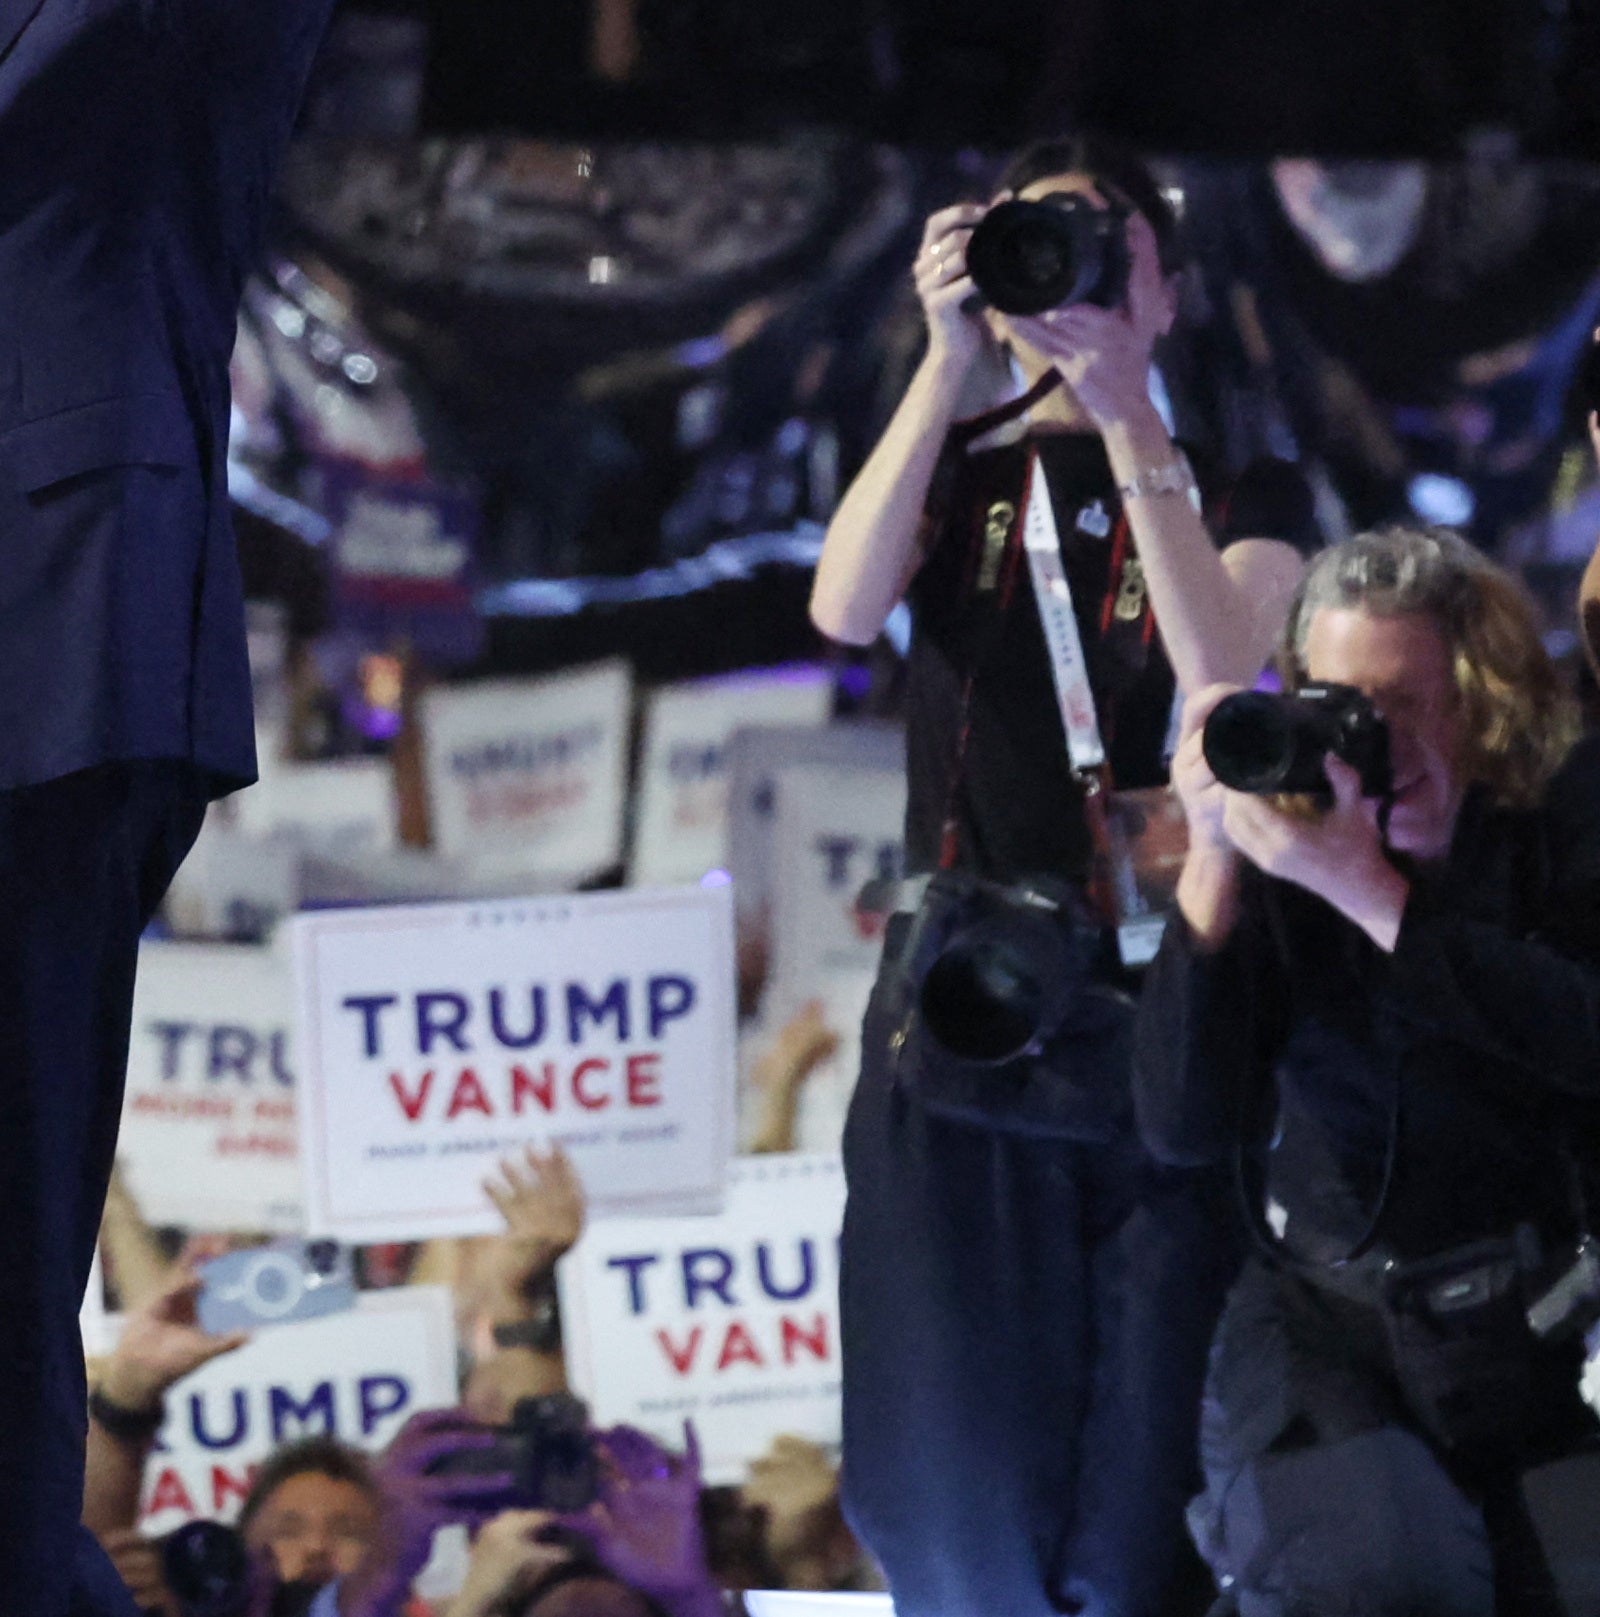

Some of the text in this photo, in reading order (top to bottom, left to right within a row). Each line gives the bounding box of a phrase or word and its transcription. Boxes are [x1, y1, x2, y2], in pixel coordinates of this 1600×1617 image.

[341, 973, 697, 1059] TRUMP
[387, 1053, 665, 1122] VANCE
[607, 1237, 840, 1315] TRU
[655, 1313, 829, 1376] VAN
[153, 1375, 410, 1453] UMP
